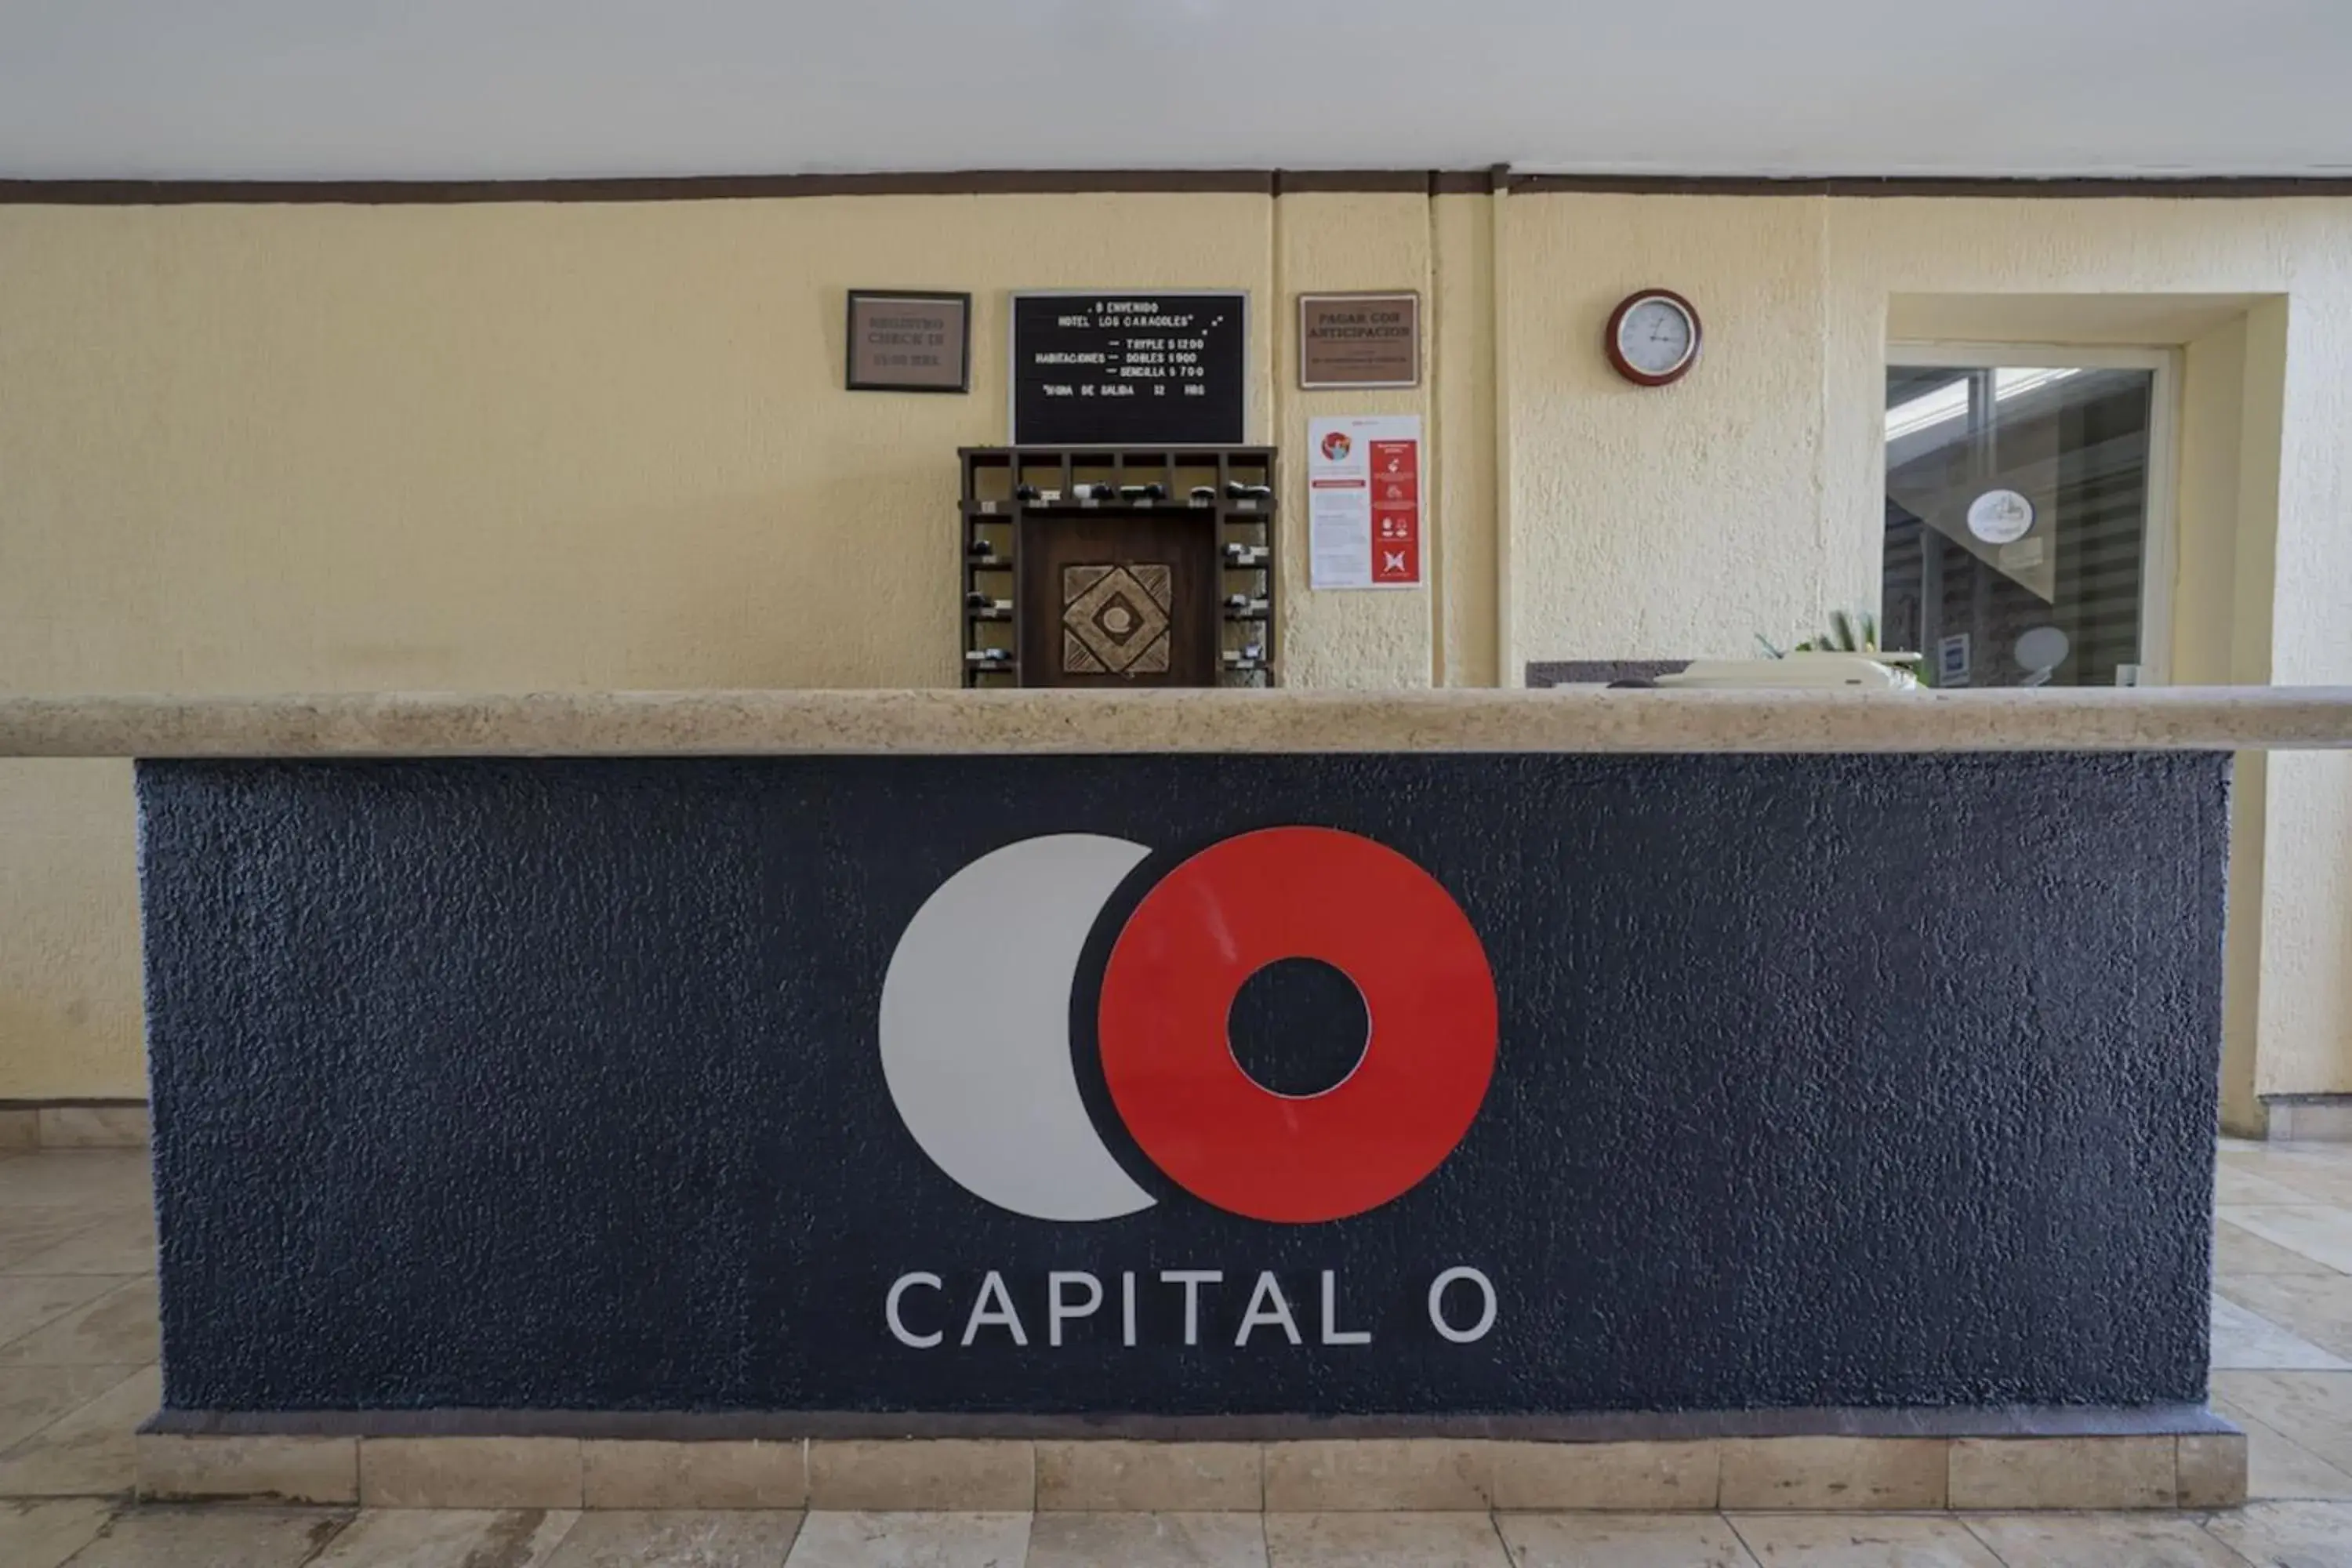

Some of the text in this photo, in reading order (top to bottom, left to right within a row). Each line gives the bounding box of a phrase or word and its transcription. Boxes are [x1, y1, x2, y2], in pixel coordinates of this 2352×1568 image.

[1058, 315, 1090, 327] HOTEL
[1098, 315, 1120, 327] LOS
[1319, 314, 1367, 325] PAGAR
[1126, 353, 1164, 363] DOBLES
[884, 1265, 1498, 1348] CAPITAL O
